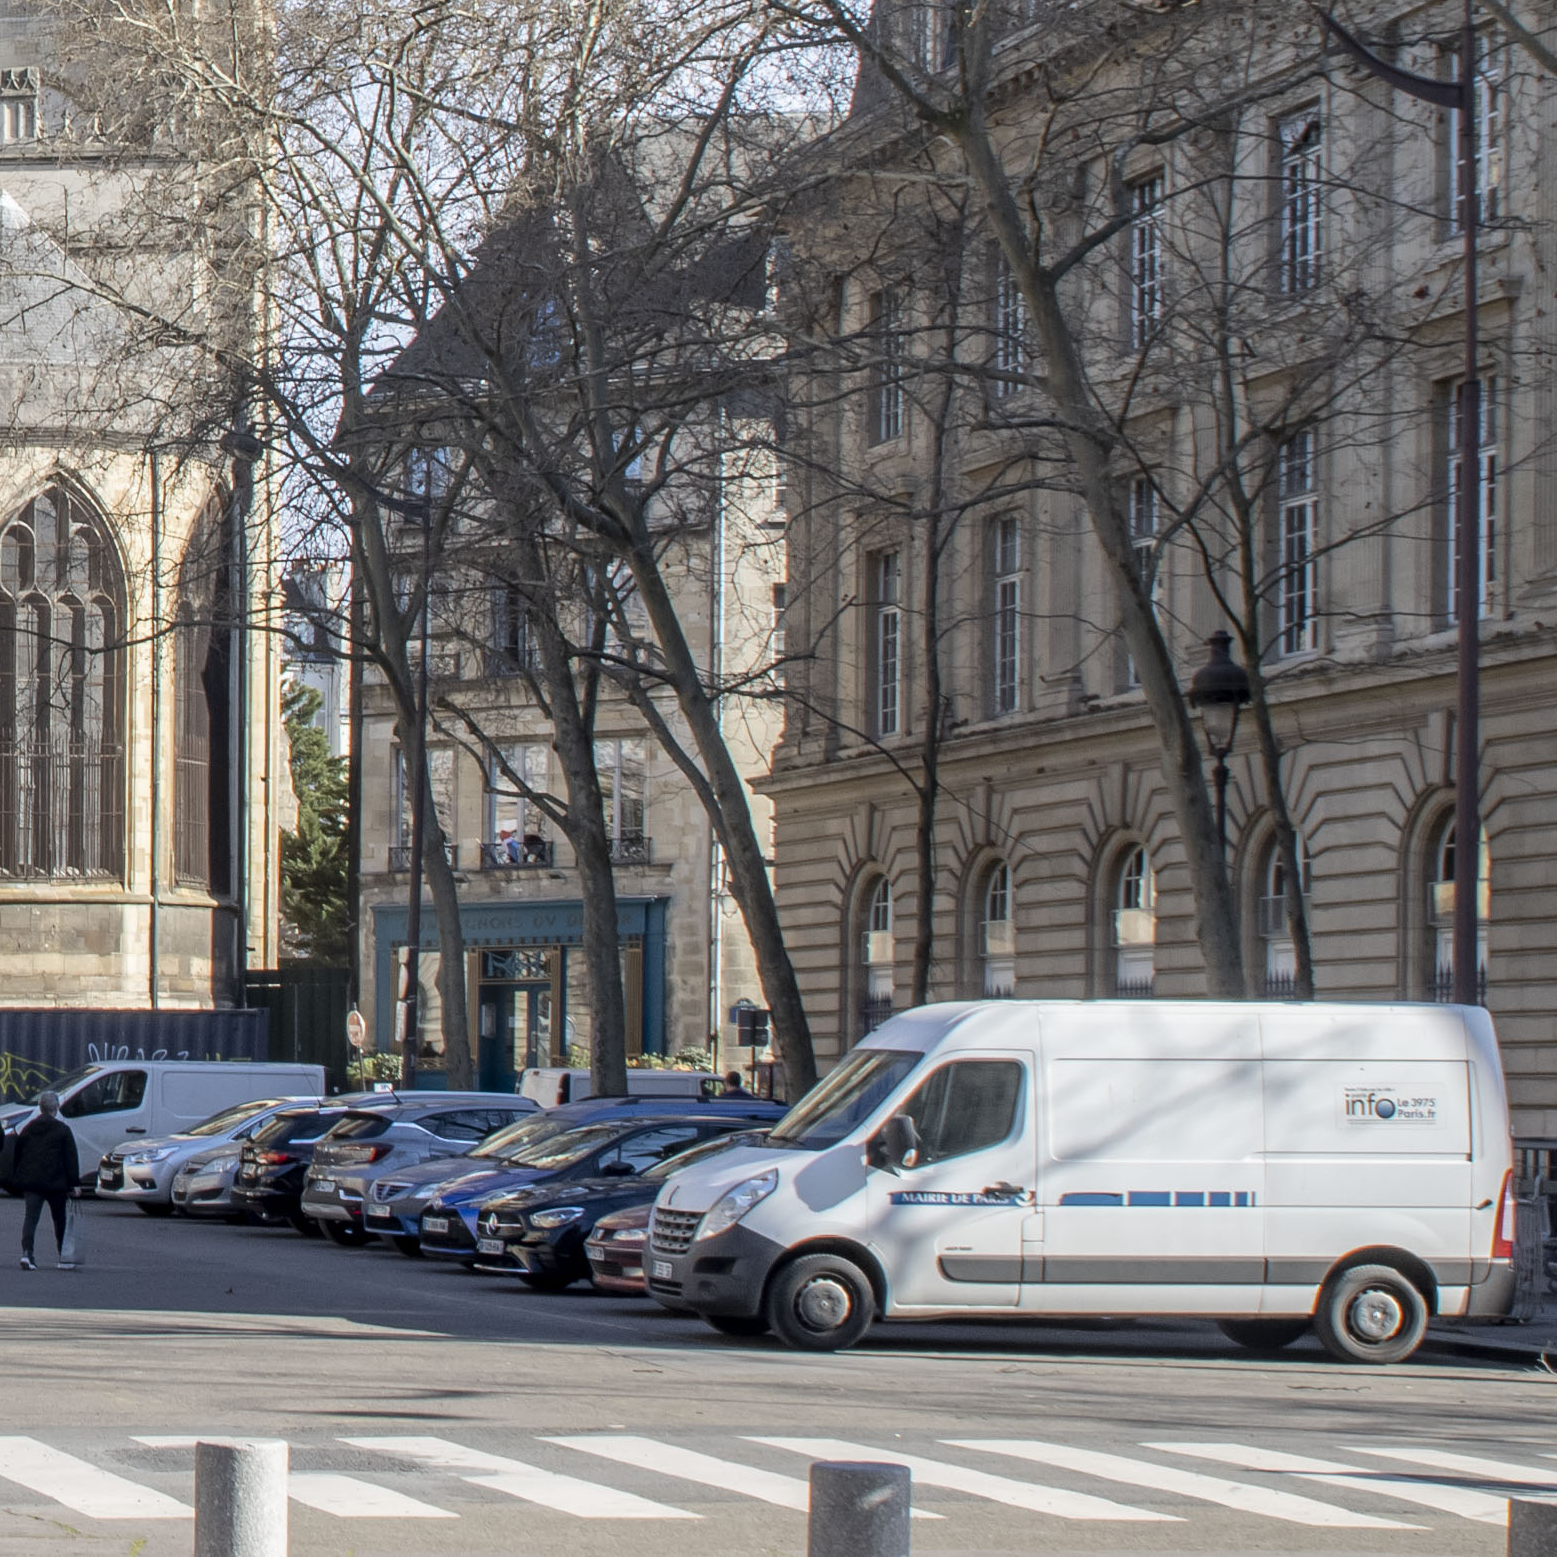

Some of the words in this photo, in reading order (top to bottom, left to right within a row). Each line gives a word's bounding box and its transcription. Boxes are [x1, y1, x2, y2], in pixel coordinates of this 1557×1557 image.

[1345, 1093, 1396, 1119] info
[1397, 1098, 1409, 1107] Le
[1411, 1098, 1436, 1107] 3975
[1397, 1109, 1436, 1118] Paris.fr
[901, 1192, 949, 1203] MAIRIE
[951, 1193, 970, 1203] DE
